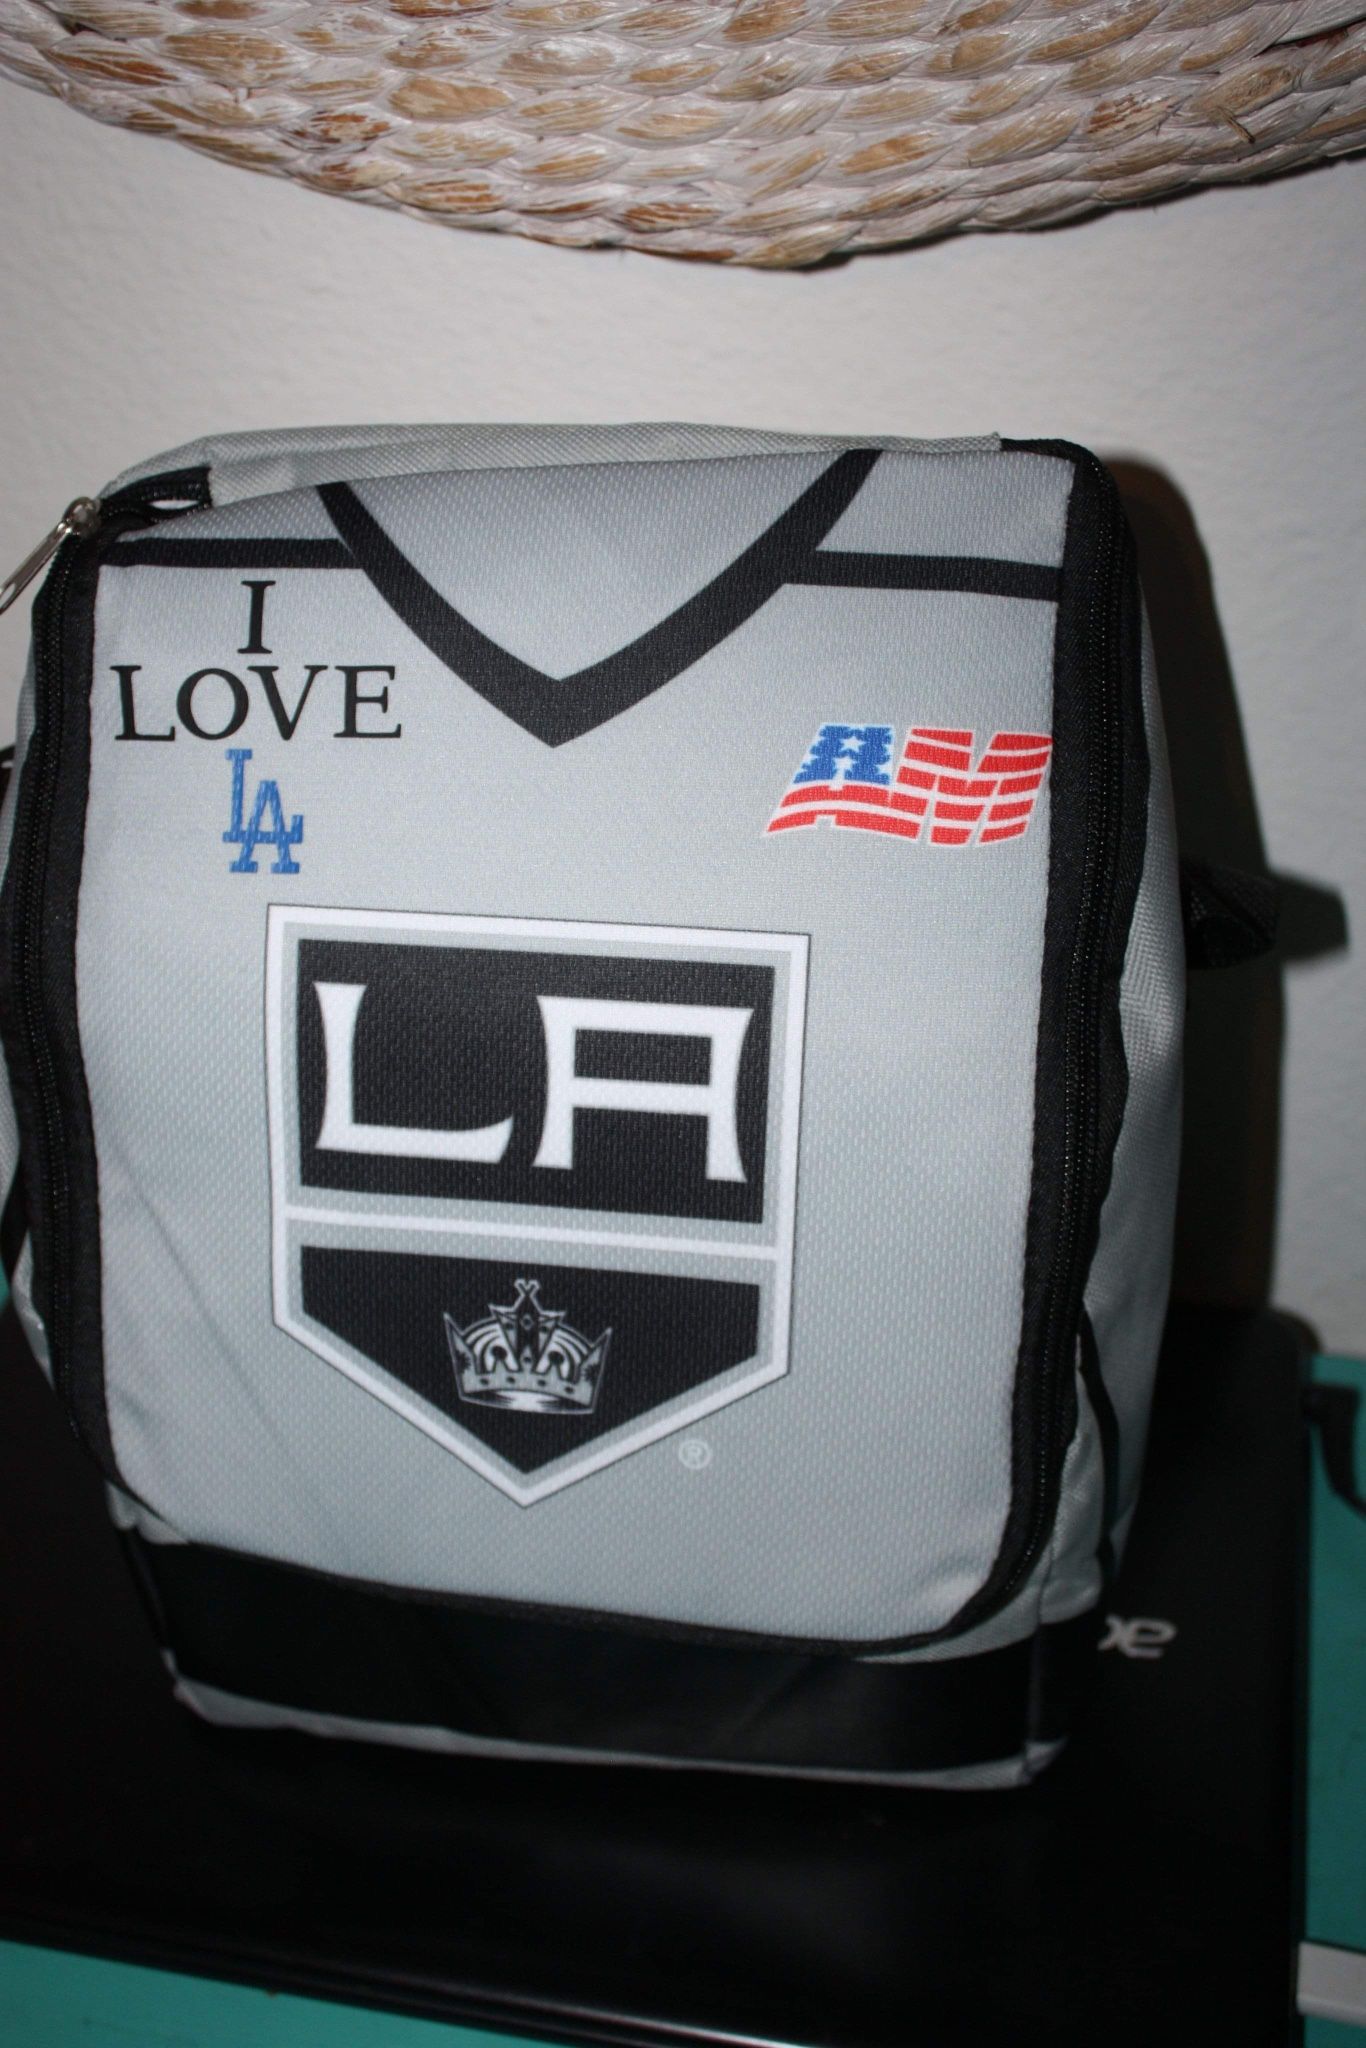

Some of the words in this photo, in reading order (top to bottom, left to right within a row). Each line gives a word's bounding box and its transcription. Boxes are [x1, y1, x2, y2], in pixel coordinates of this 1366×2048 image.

[237, 579, 277, 655] I
[109, 664, 402, 742] LOVE
[222, 748, 304, 875] LA
[312, 980, 756, 1184] LA
